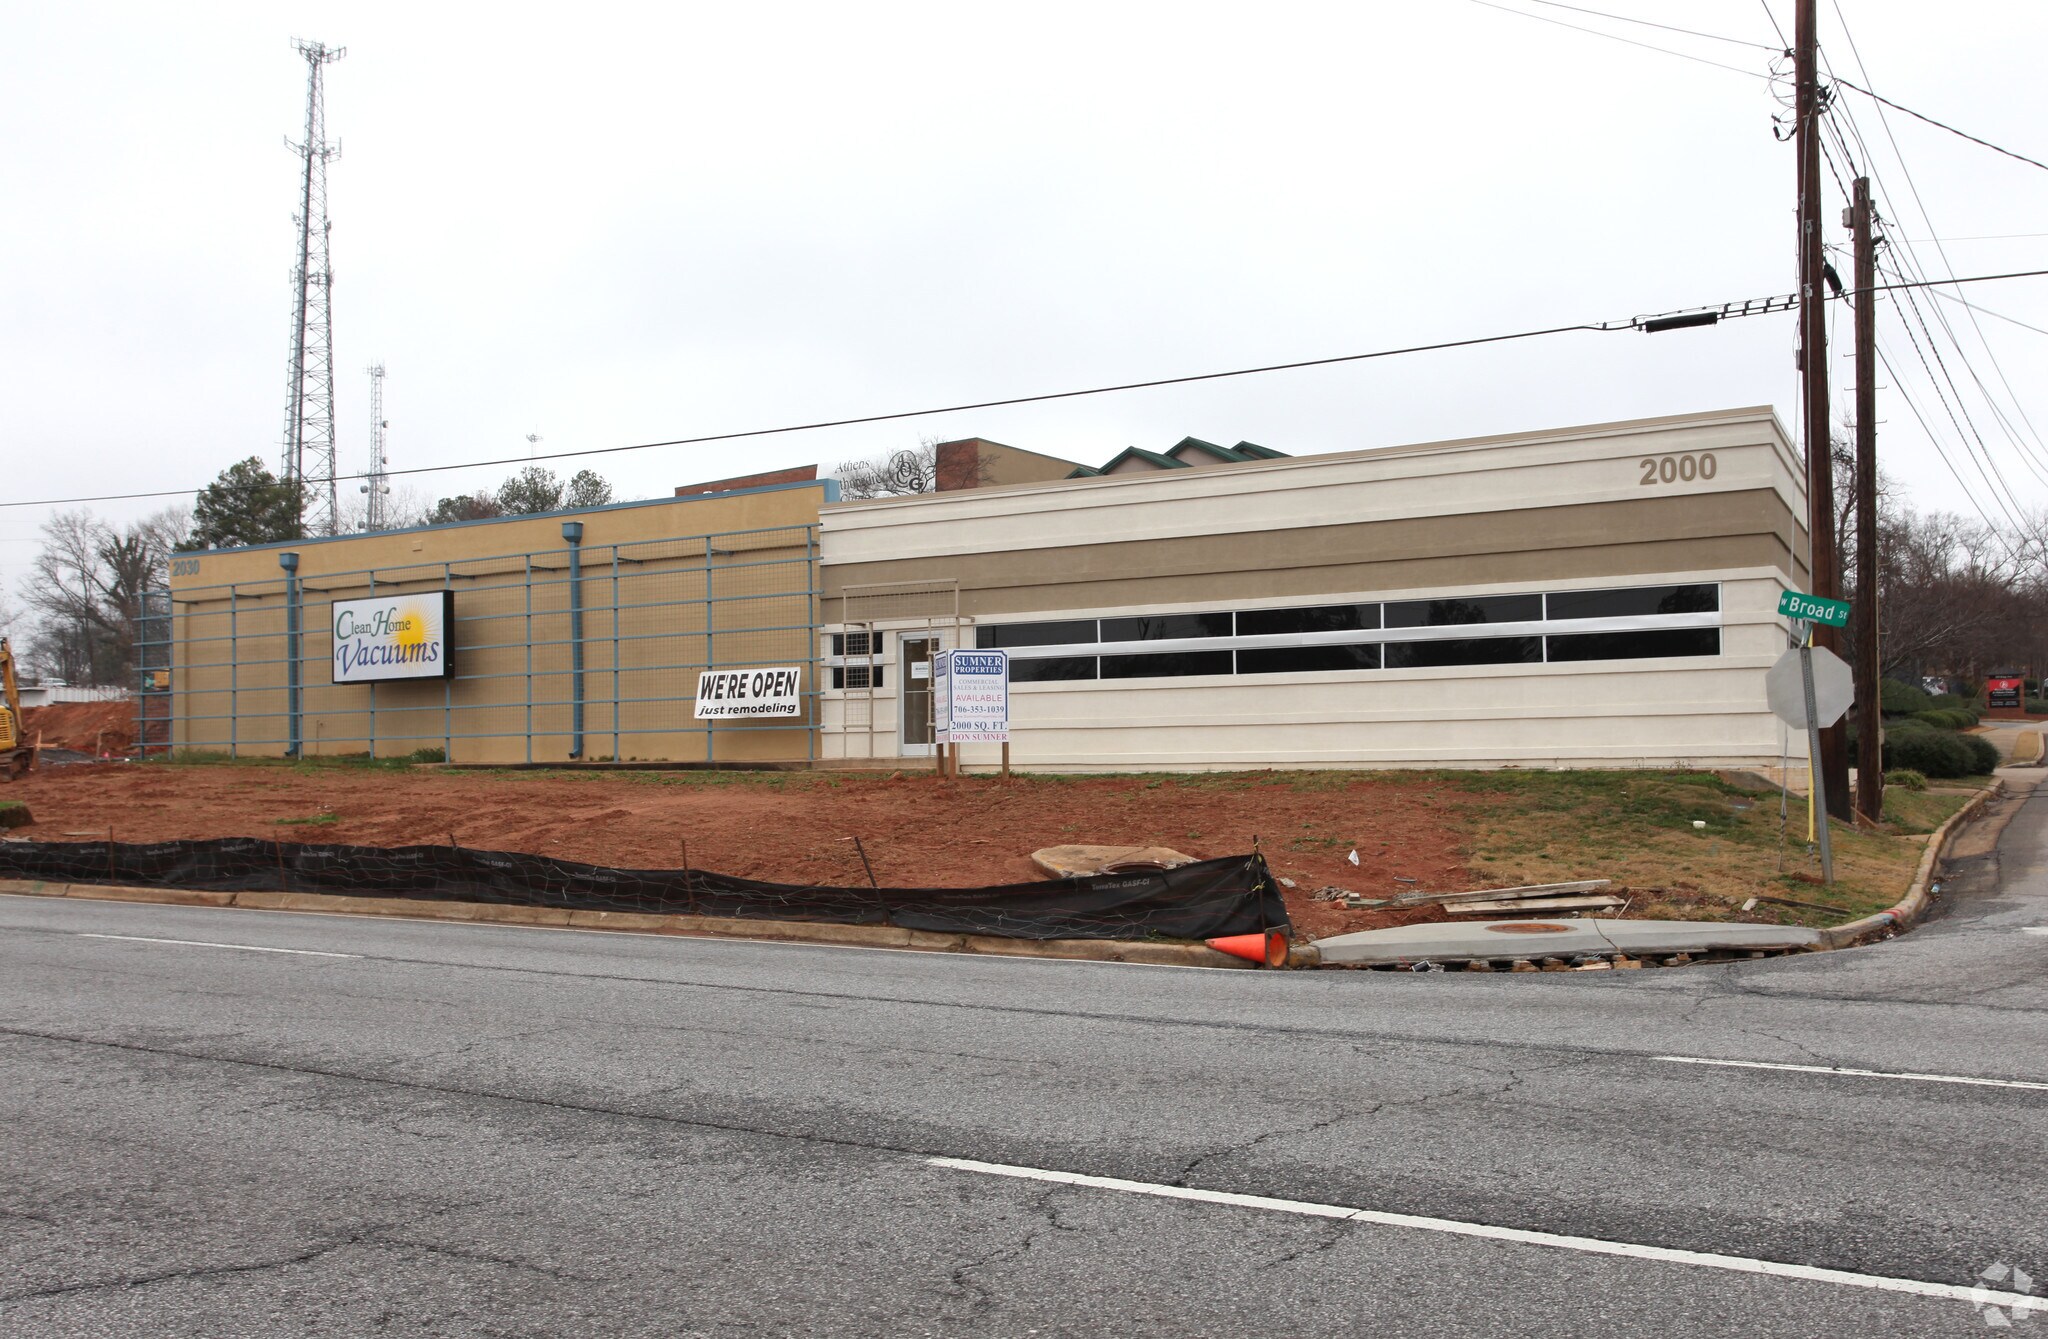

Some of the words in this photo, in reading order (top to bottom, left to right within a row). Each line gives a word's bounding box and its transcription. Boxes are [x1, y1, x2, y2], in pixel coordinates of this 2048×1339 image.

[835, 460, 870, 473] Athens
[1640, 453, 1717, 485] 2000
[840, 472, 882, 491] thopedic
[172, 560, 200, 577] 2030
[1781, 598, 1788, 606] W
[1789, 597, 1835, 620] Broad
[1838, 610, 1848, 619] St
[336, 610, 371, 640] Clean
[371, 607, 411, 637] Home
[336, 638, 439, 676] Vacuums
[955, 656, 1002, 666] SUMNER
[700, 674, 749, 700] WE'RE
[752, 671, 798, 698] OPEN
[955, 694, 1002, 702] AVAILABLE
[699, 705, 725, 716] just
[727, 703, 796, 715] remodeling
[954, 705, 1004, 713] 706-353-1039
[951, 721, 972, 730] 2000
[974, 721, 990, 731] SQ.
[993, 721, 1007, 730] FT.
[952, 733, 970, 741] DON
[972, 733, 1007, 741] SUMNER
